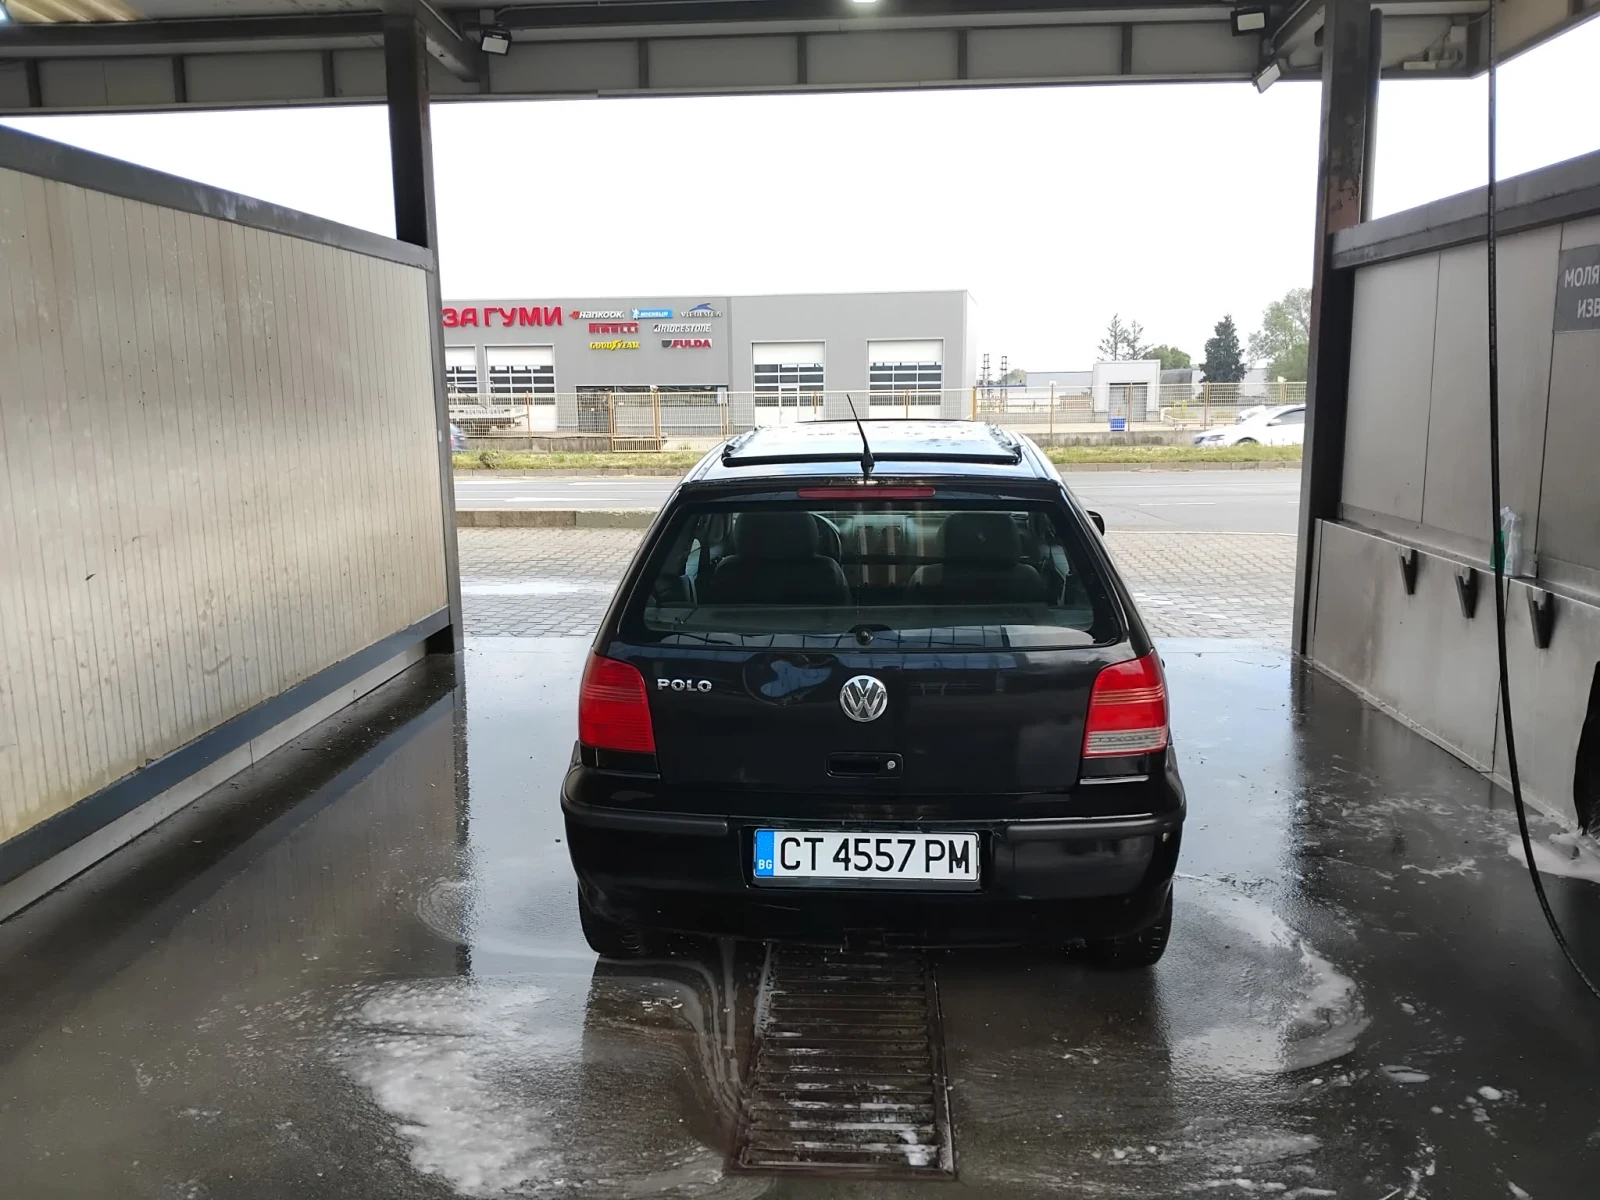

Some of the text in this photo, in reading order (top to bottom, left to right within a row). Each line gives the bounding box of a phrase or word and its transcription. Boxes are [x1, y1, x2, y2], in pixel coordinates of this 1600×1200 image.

[1564, 265, 1600, 288] МОЛЯ
[442, 306, 563, 328] ЗА ГУМИ
[588, 322, 639, 334] PIRELLI
[653, 323, 712, 333] BRIDGESTONE
[589, 339, 640, 350] GOODYEAR
[671, 339, 712, 349] FULDA
[657, 678, 712, 693] POLO
[832, 838, 916, 872] 4557
[924, 839, 970, 873] PM
[758, 859, 773, 870] BG
